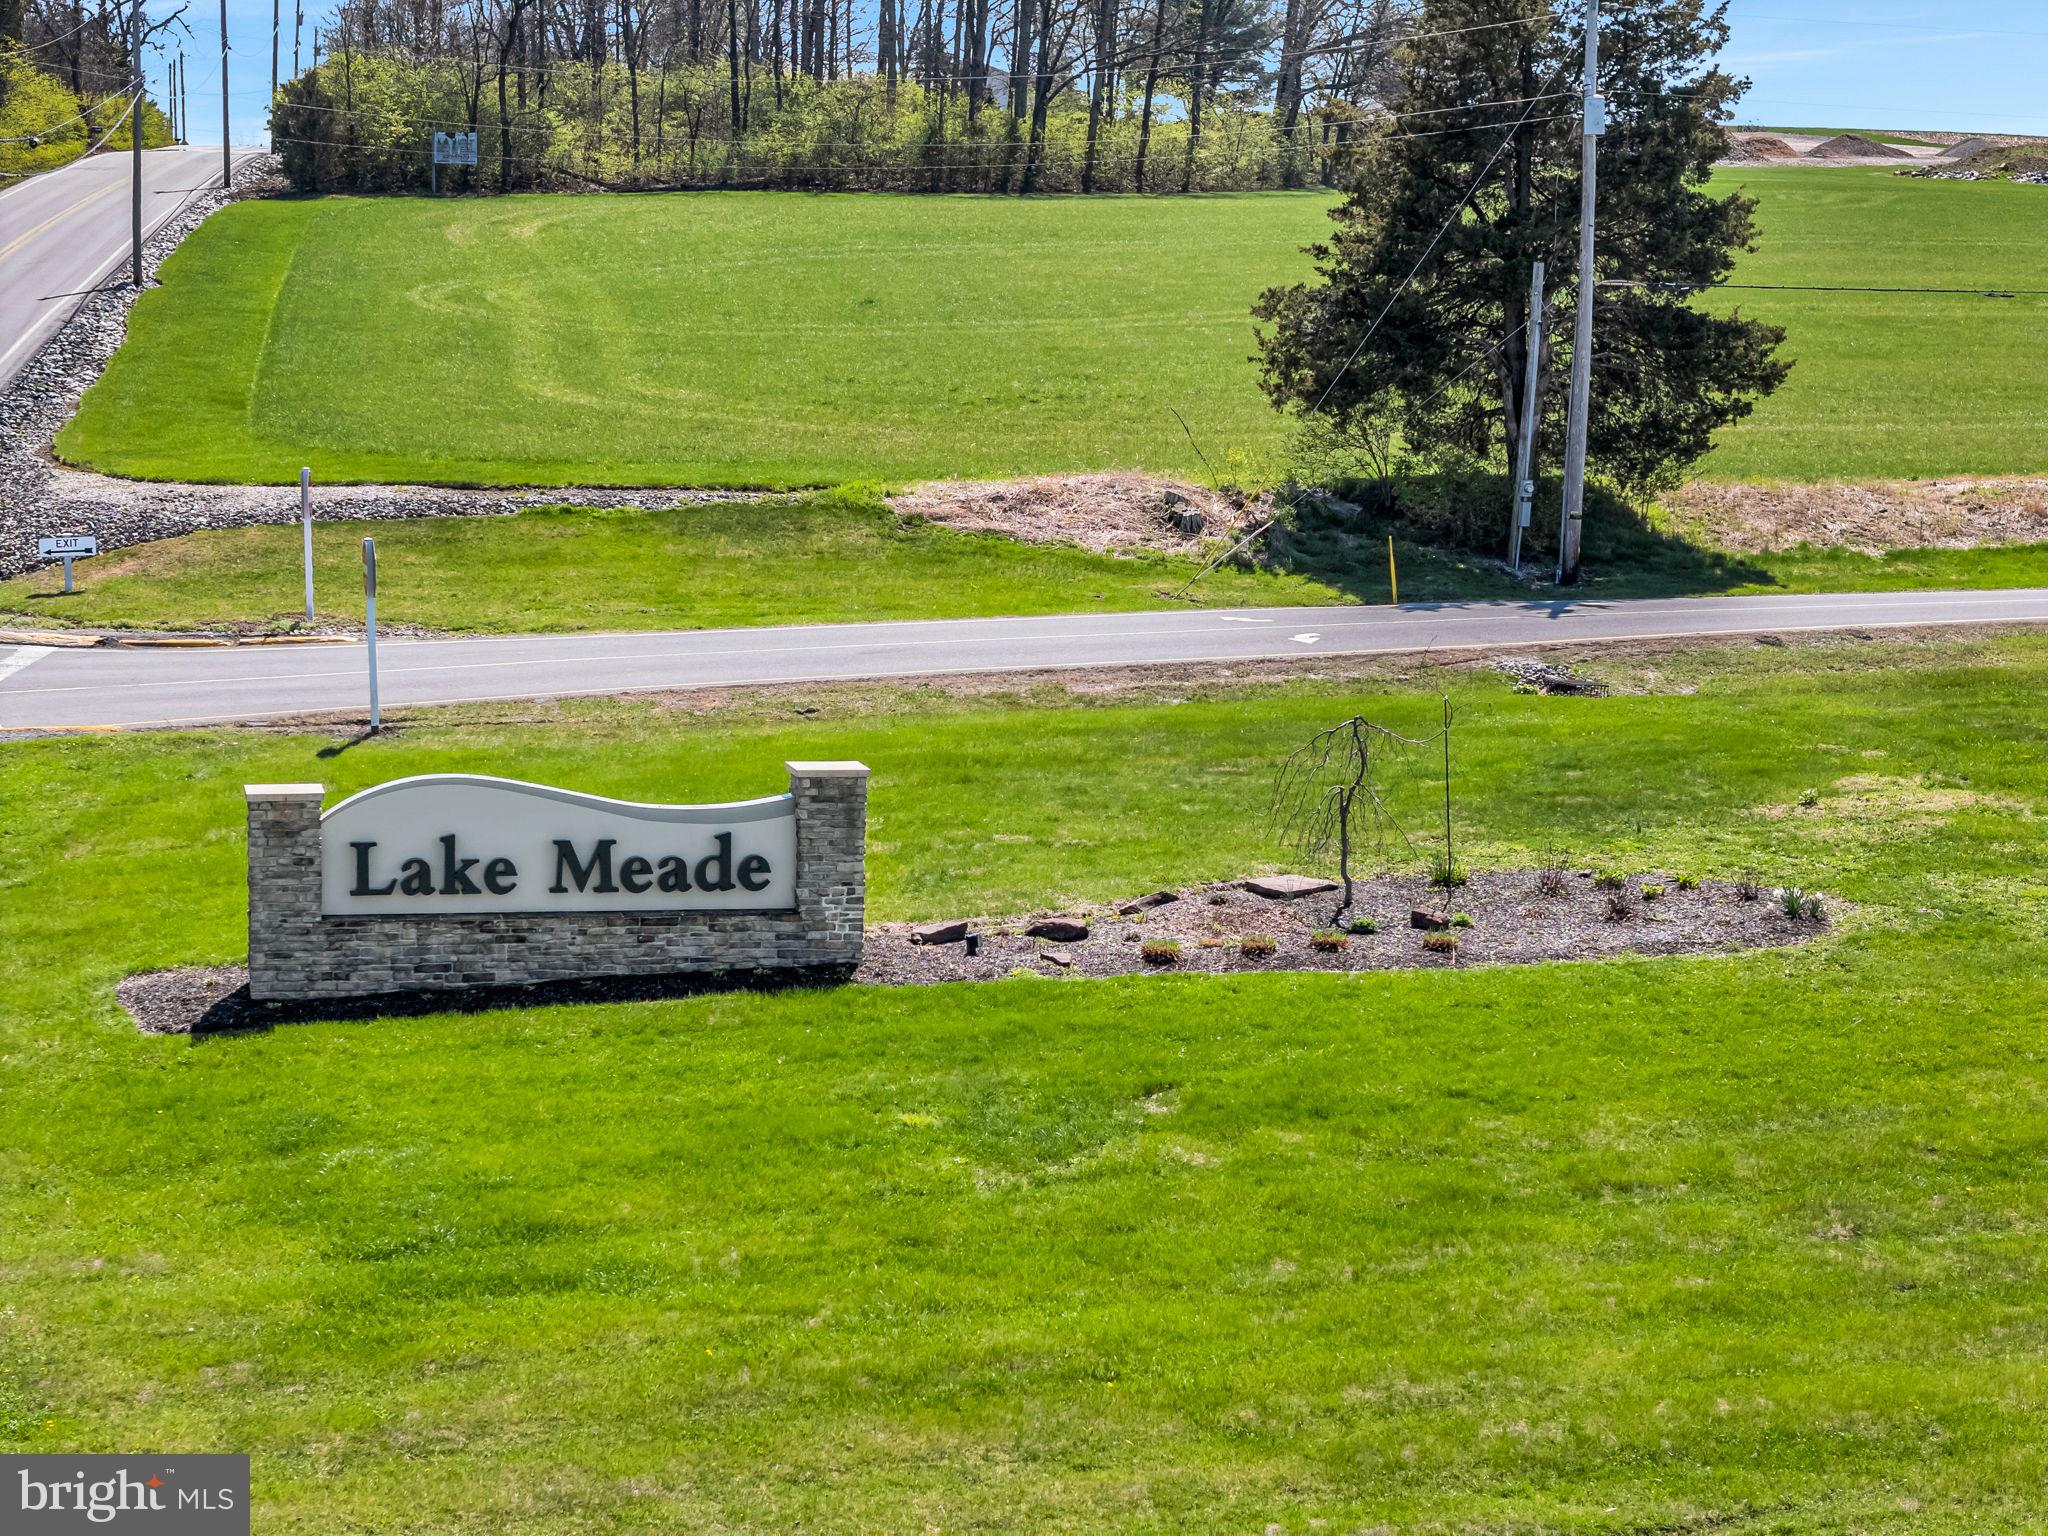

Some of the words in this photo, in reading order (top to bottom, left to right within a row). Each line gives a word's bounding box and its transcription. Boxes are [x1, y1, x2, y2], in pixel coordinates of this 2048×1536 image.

[55, 538, 79, 548] EXIT
[349, 833, 518, 897] Lake
[548, 831, 772, 894] Meade
